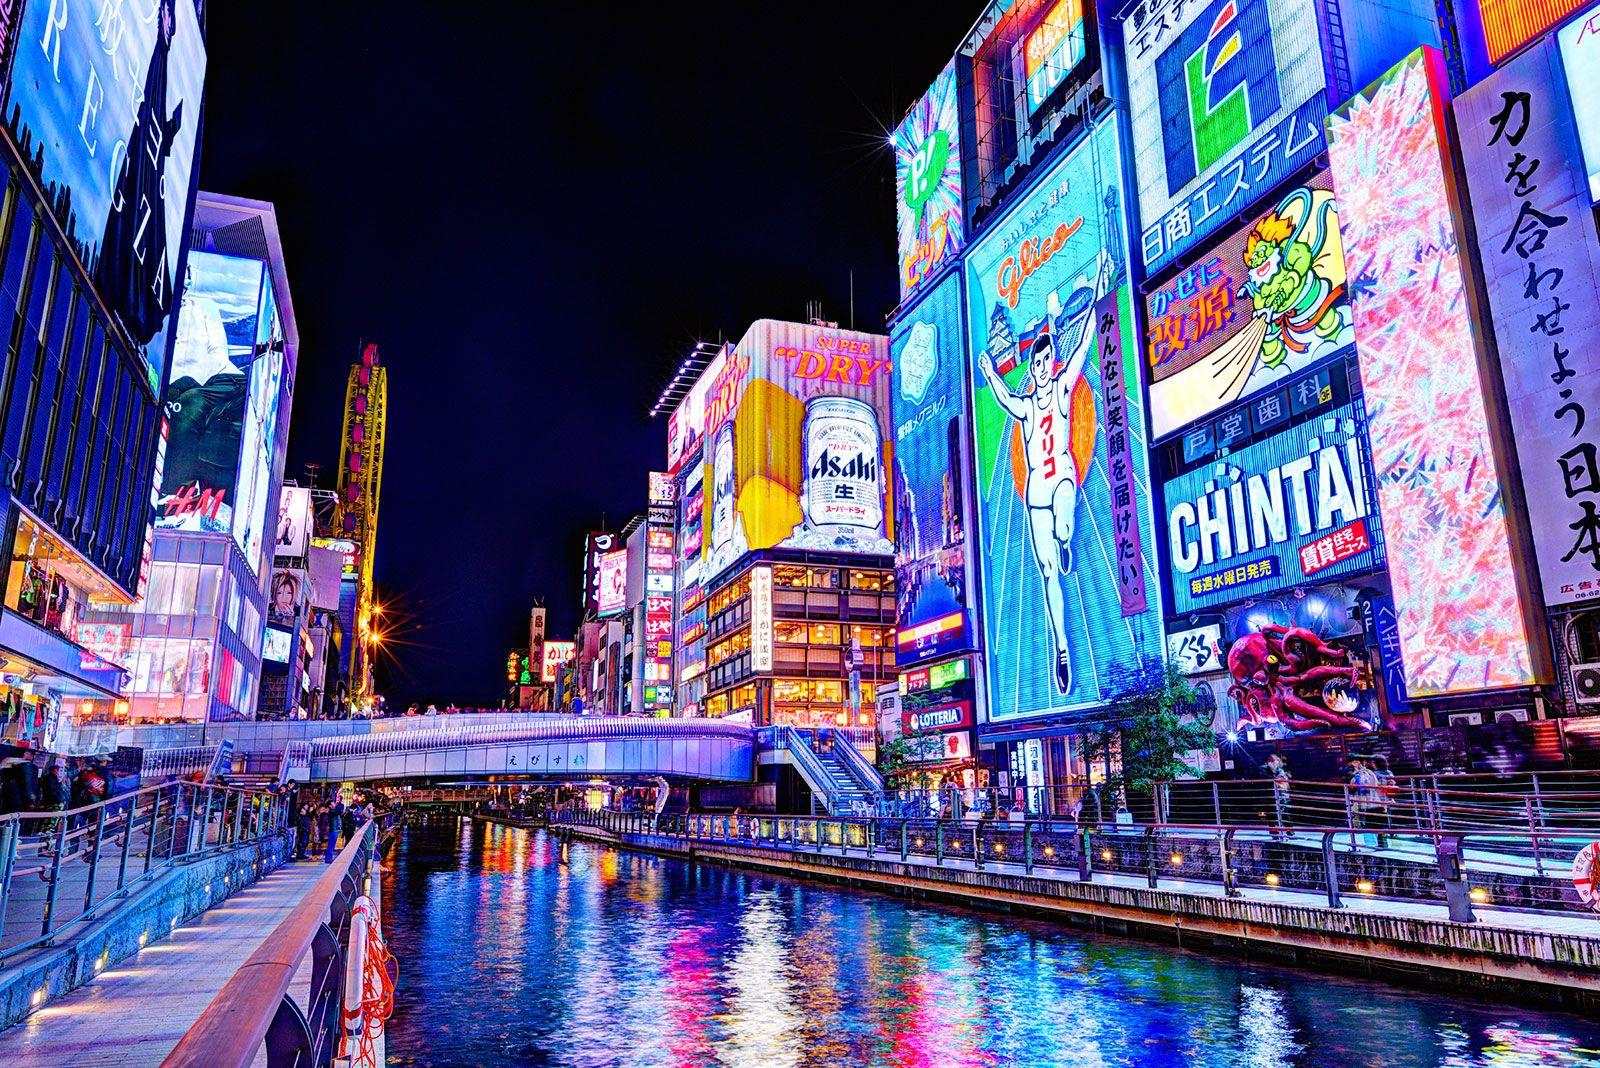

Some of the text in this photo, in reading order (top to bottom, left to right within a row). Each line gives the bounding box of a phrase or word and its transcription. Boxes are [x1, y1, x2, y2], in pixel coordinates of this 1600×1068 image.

[1141, 115, 1319, 266] 日商エステム
[997, 216, 1084, 309] Glico
[1150, 257, 1226, 318] かぜに
[1146, 280, 1233, 368] 改源
[816, 337, 871, 354] SUPER
[1320, 388, 1331, 401] 3F
[1040, 412, 1056, 479] グリコ
[1100, 311, 1139, 596] みんなに笑顔を届けたい。
[811, 448, 876, 483] Asahi
[165, 485, 226, 521] H&M
[835, 484, 855, 499] 生
[1170, 434, 1366, 573] CHINTAI
[826, 505, 866, 515] スーパードライ
[1334, 528, 1353, 548] 住宅
[1336, 540, 1367, 558] ニュース
[1301, 540, 1336, 575] 賃貸
[1191, 560, 1272, 595] 毎週水曜日発売
[1561, 579, 1600, 593] 広告
[1363, 601, 1372, 632] 2F
[1179, 634, 1211, 667] くくる
[919, 708, 958, 727] LOTTERIA
